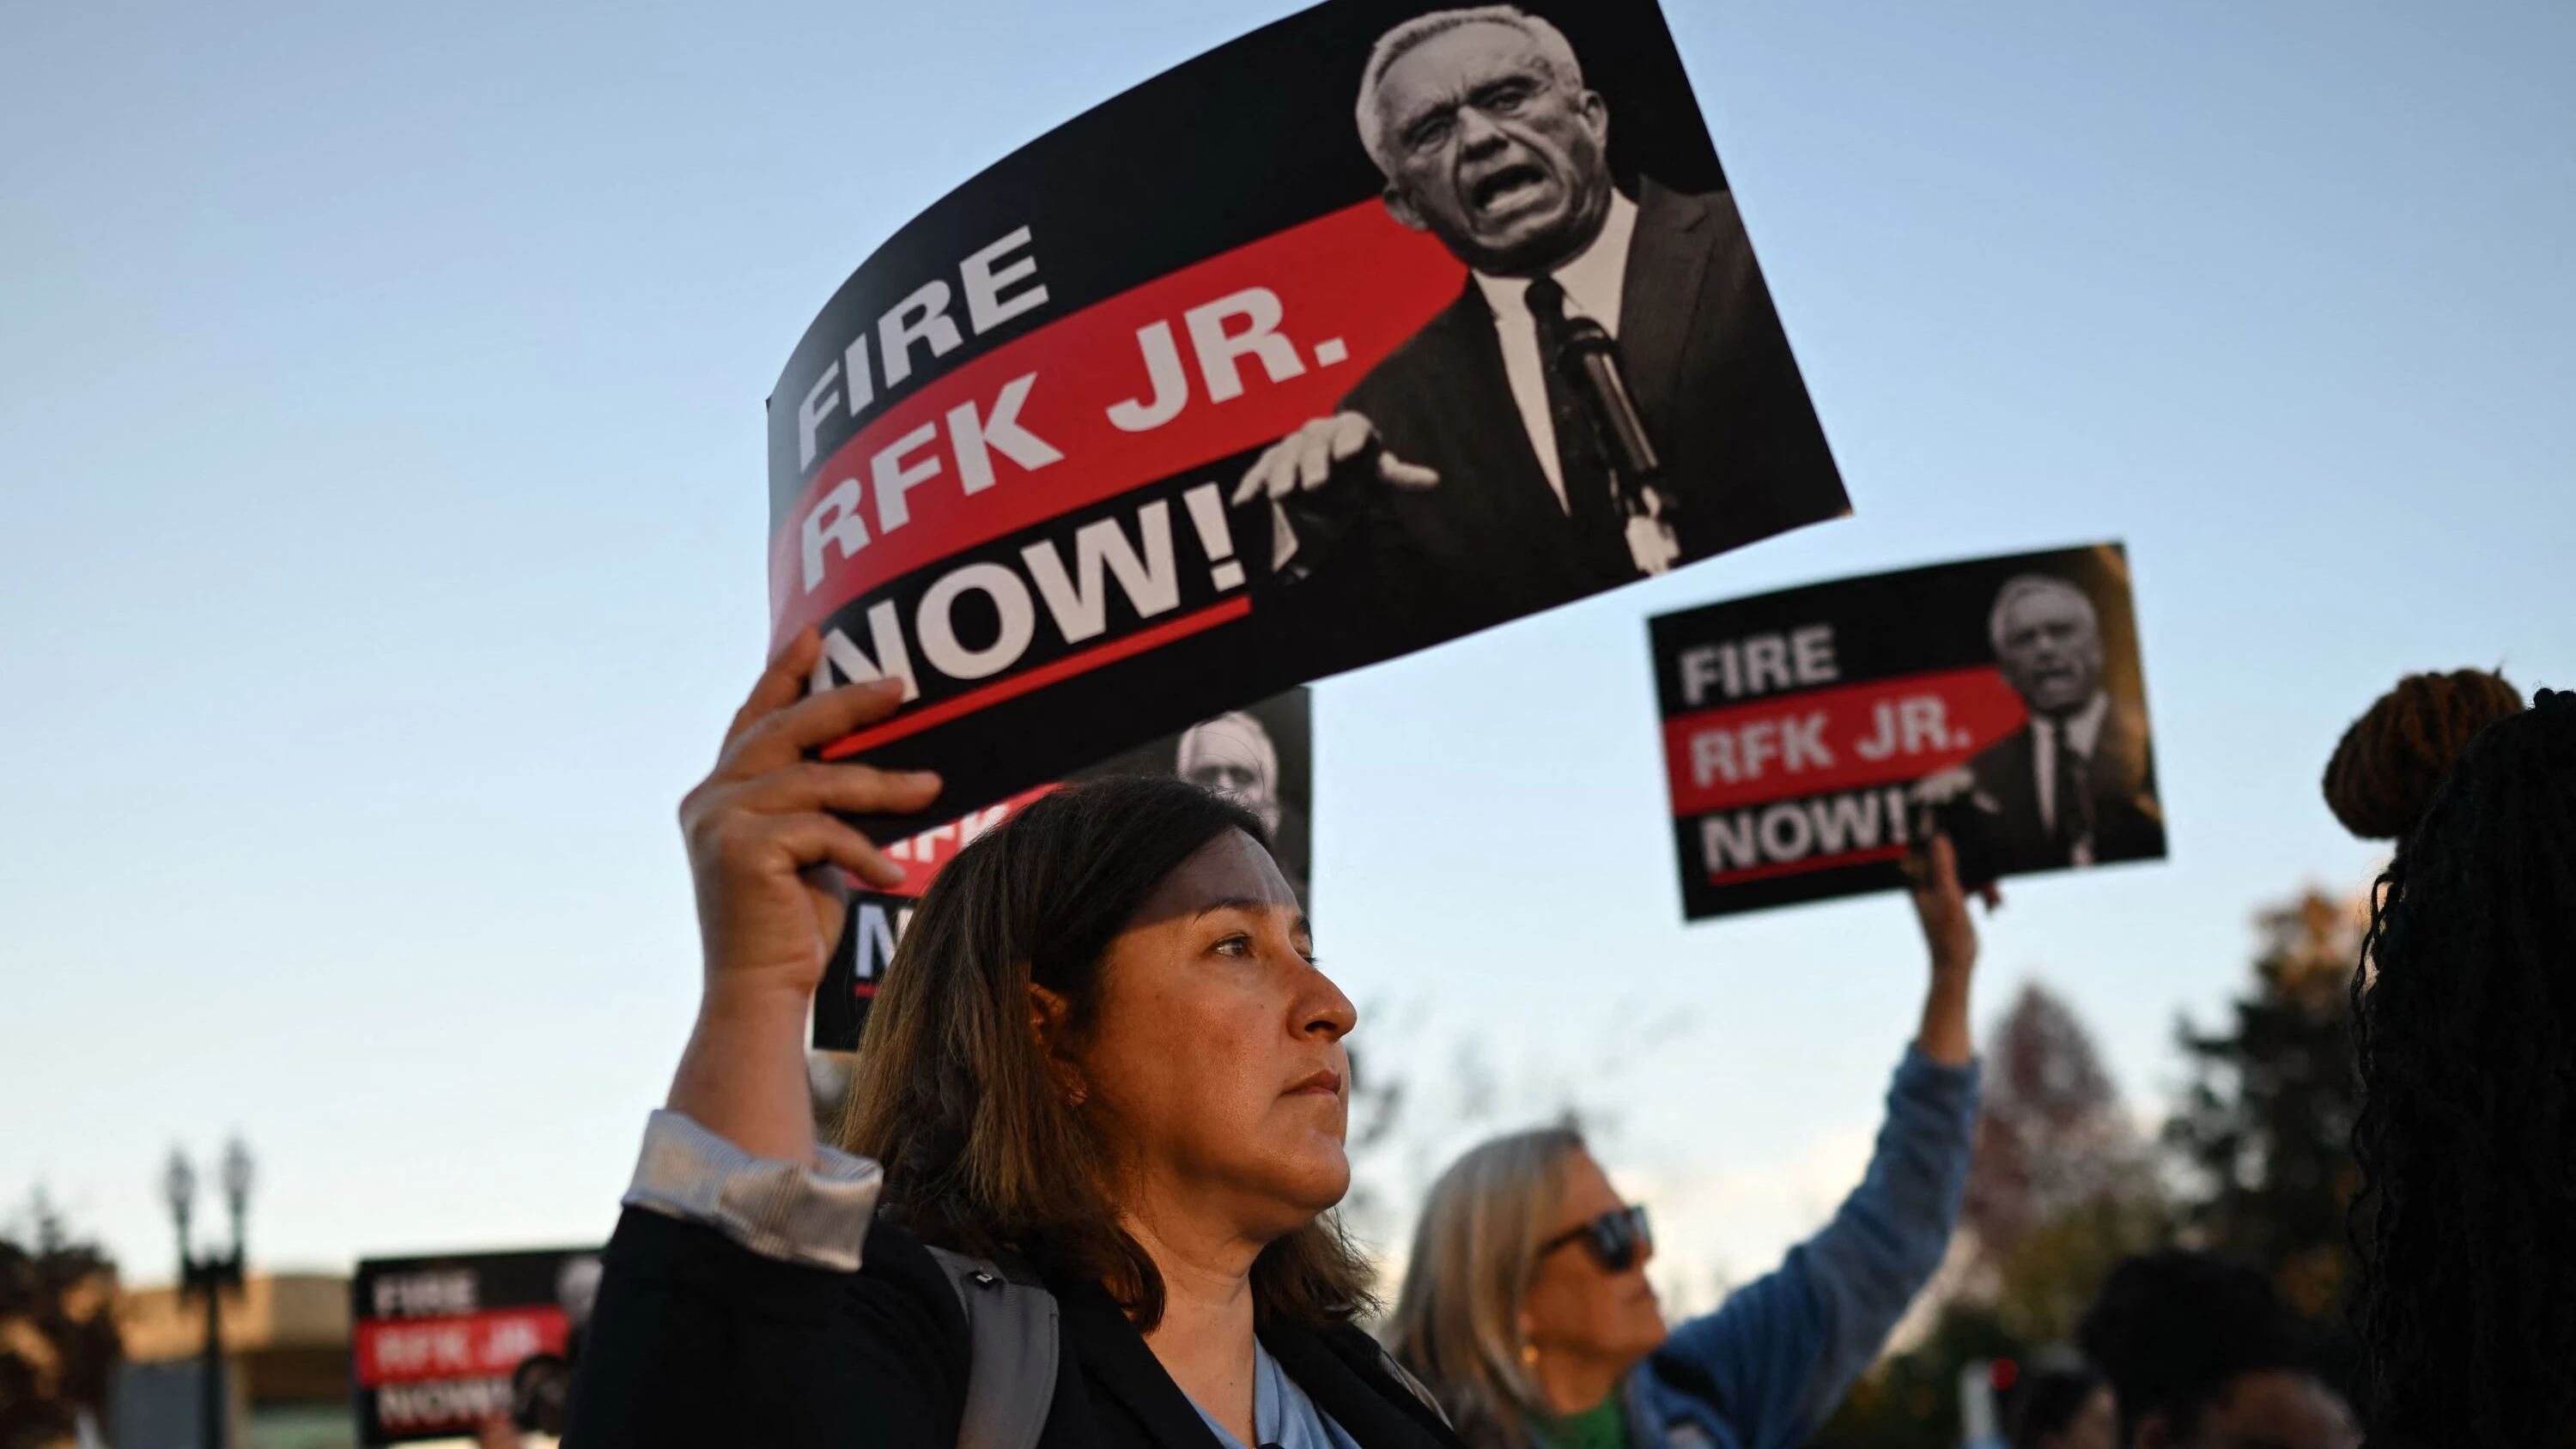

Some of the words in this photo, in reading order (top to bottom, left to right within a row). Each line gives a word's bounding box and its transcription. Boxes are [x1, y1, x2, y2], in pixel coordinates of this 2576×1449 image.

[799, 225, 1049, 474] FIRE
[801, 371, 1066, 596] RFK
[1106, 286, 1349, 433] JR.
[810, 482, 1246, 703] NOW!
[1680, 625, 1838, 706] FIRE
[1690, 712, 1835, 788] RFK
[1855, 695, 1972, 762] JR.
[1699, 787, 1909, 874] NOW!
